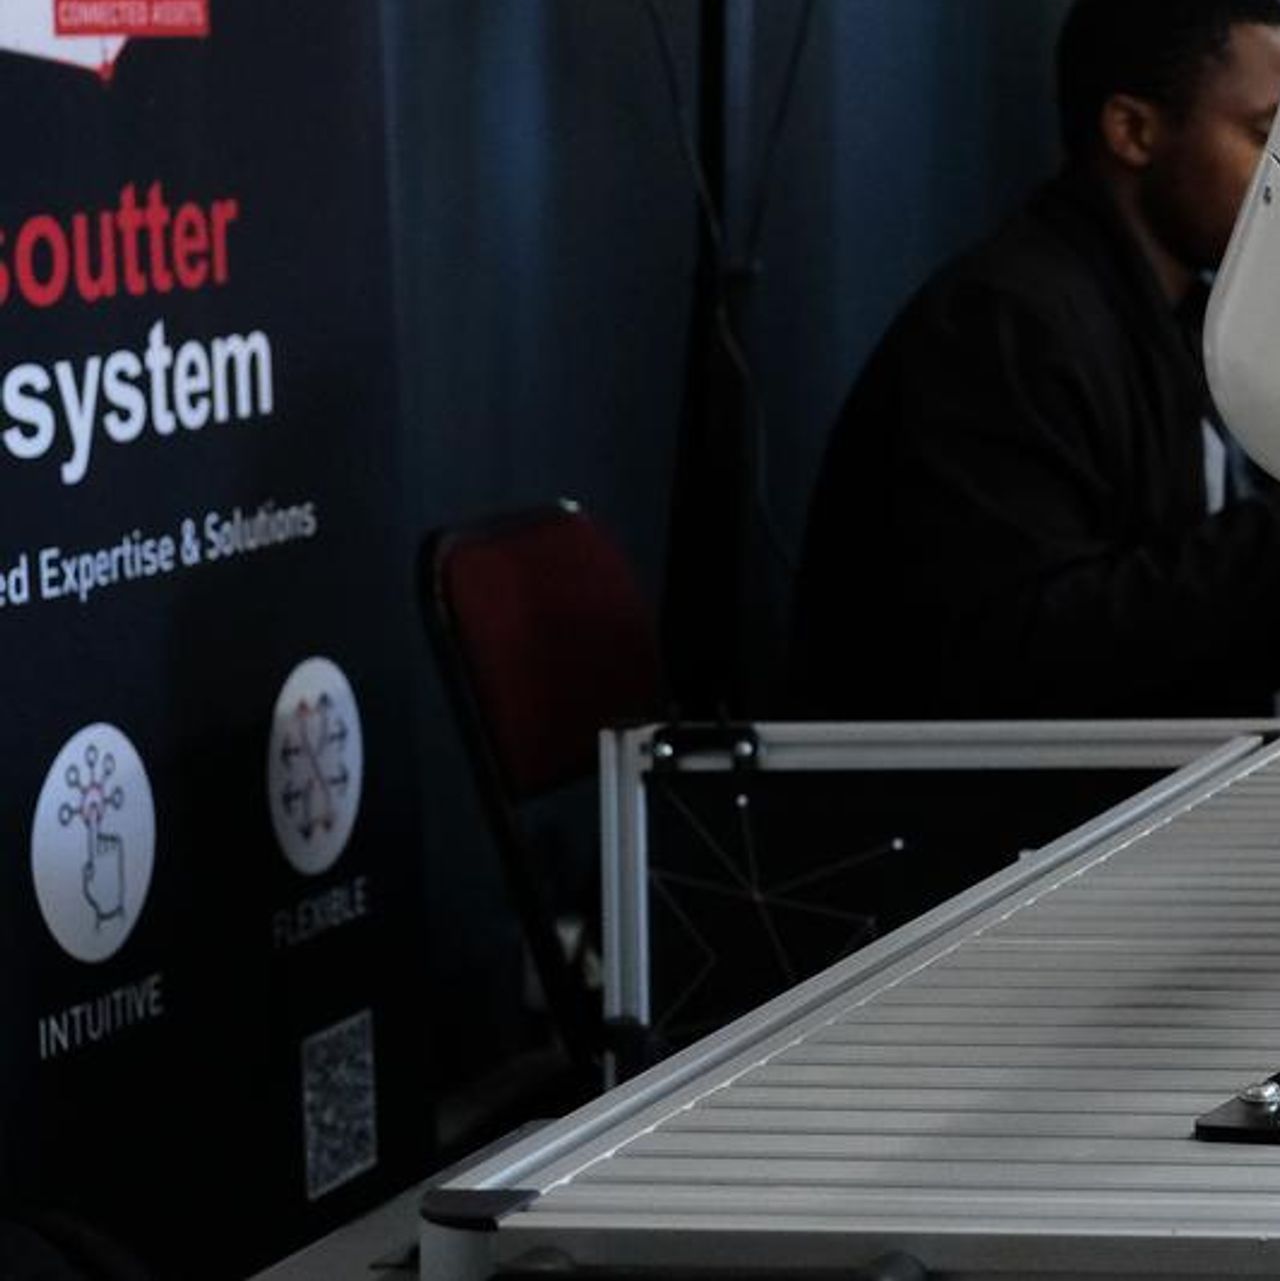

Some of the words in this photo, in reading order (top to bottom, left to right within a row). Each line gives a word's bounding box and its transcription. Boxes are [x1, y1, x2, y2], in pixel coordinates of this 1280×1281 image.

[0, 178, 238, 308] outter
[2, 318, 273, 485] system
[39, 529, 175, 602] Expertise
[181, 517, 201, 567] &
[204, 501, 317, 561] Solutions
[39, 973, 165, 1060] INTUITIVE
